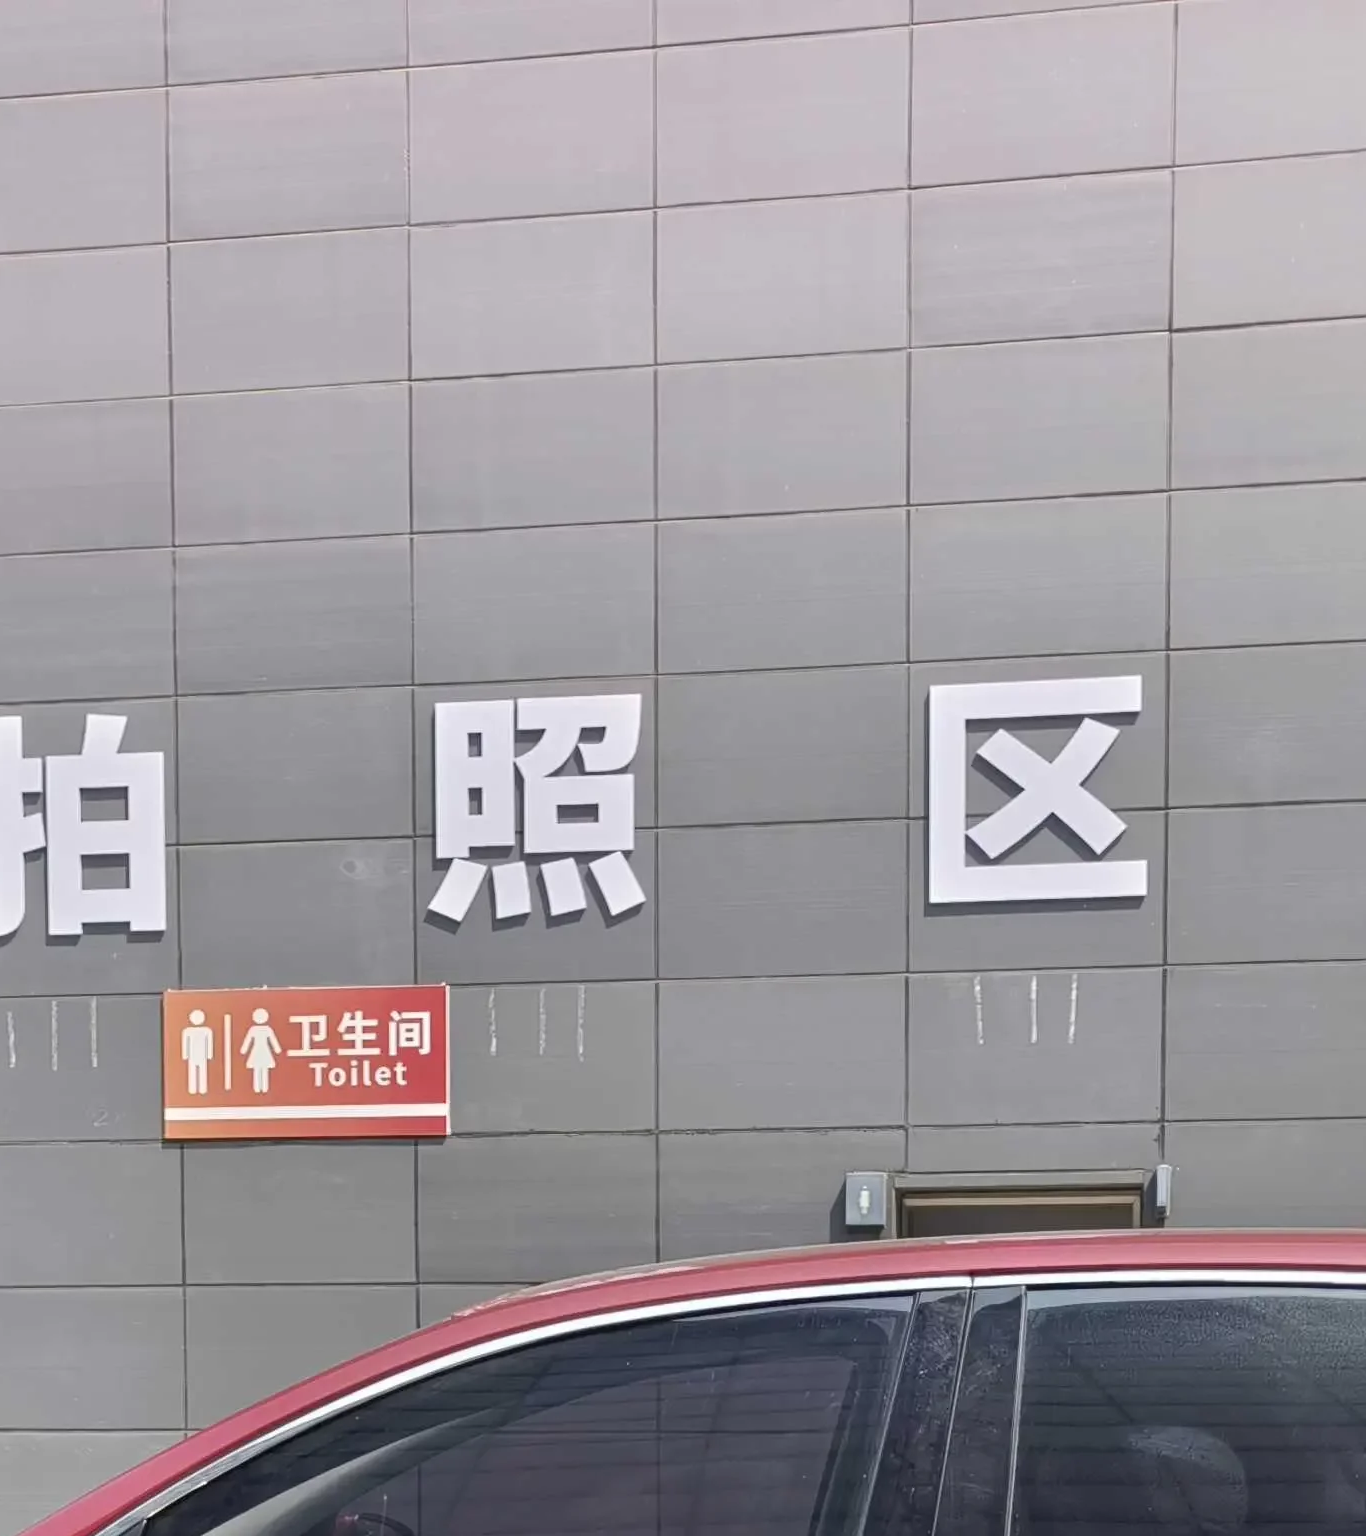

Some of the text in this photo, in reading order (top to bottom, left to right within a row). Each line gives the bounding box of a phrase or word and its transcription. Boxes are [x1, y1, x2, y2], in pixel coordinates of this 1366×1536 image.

[286, 1010, 432, 1056] 卫生间
[308, 1059, 408, 1087] Toilet
